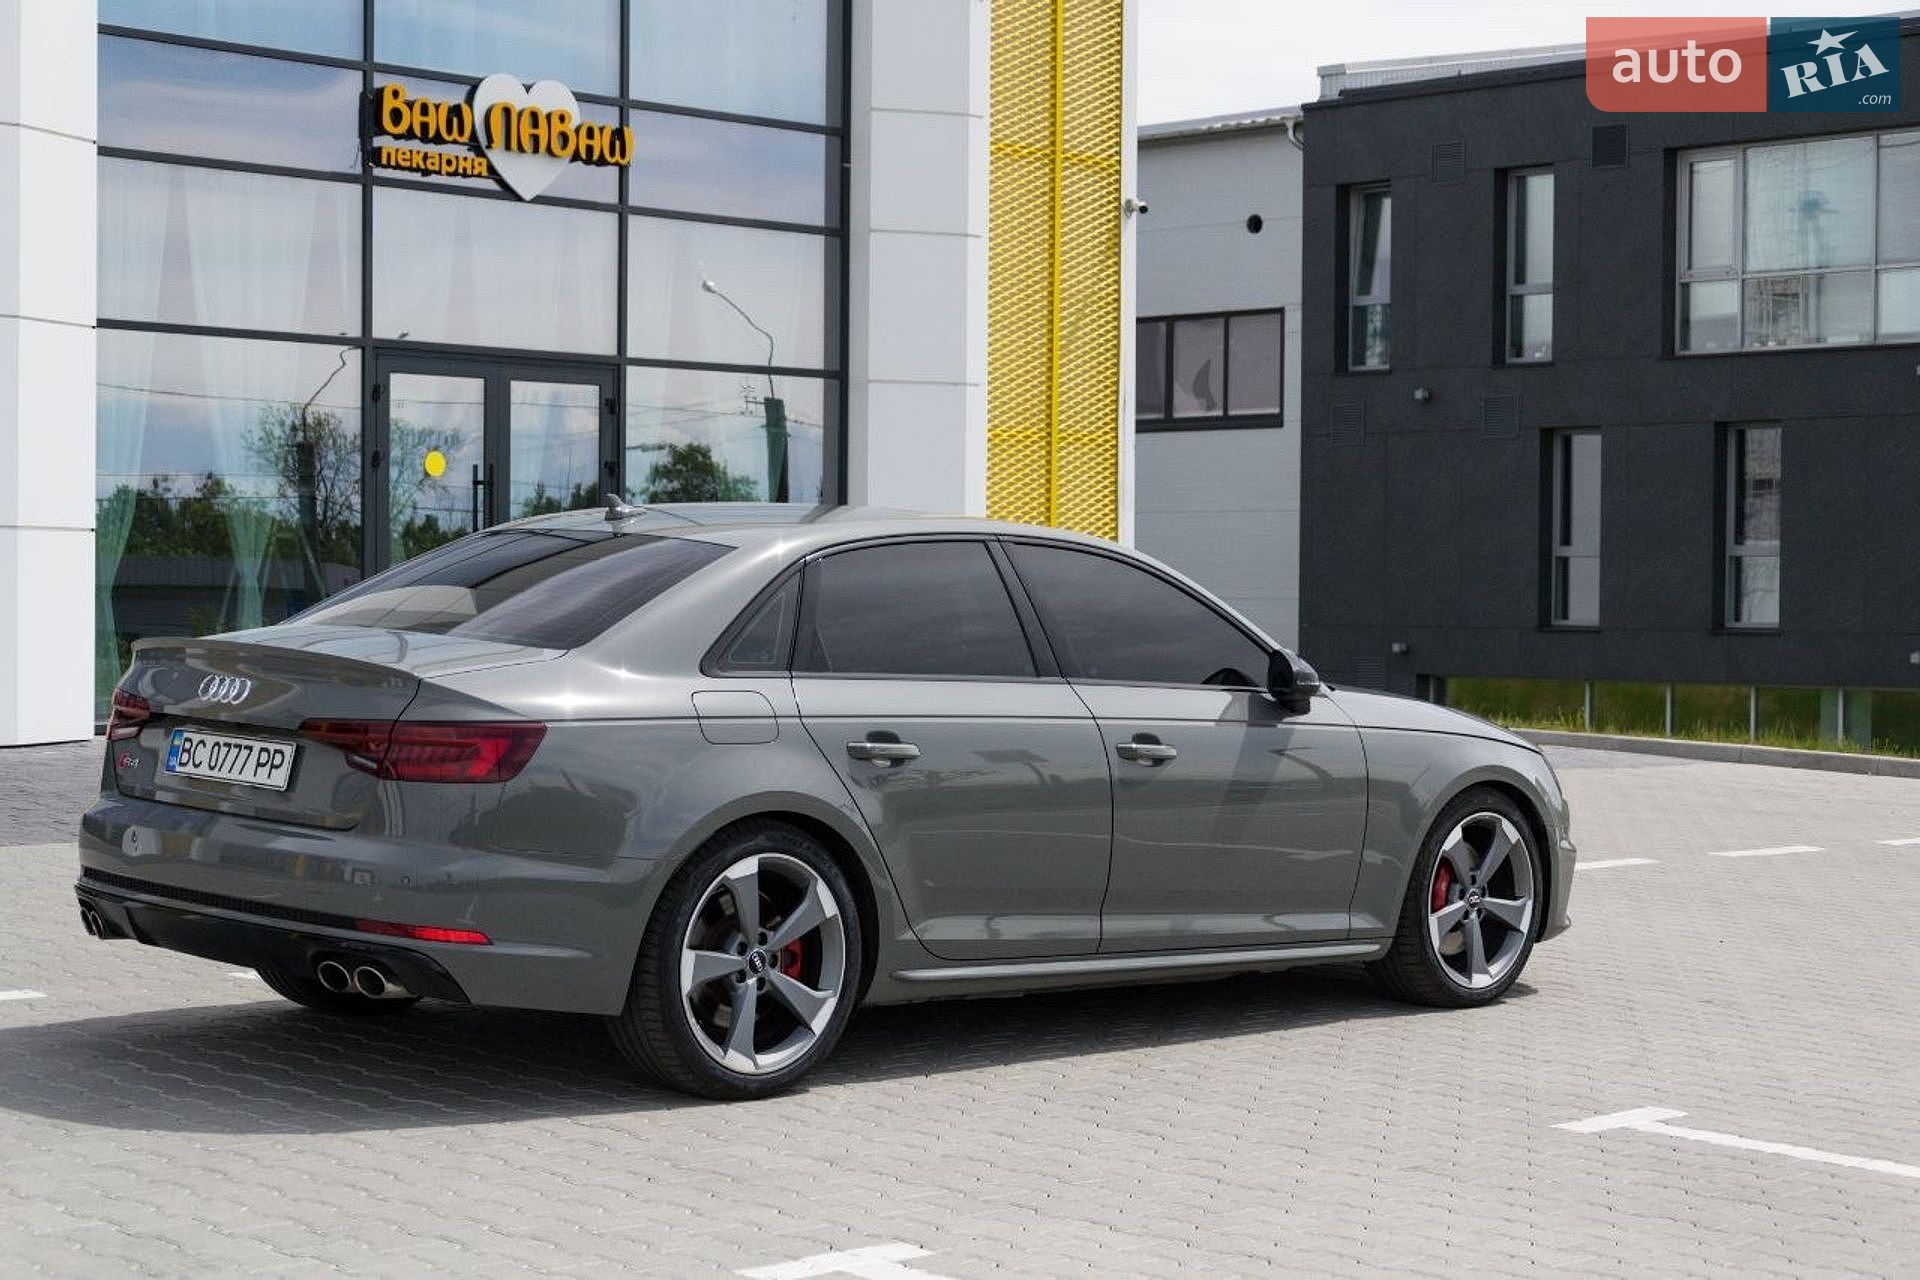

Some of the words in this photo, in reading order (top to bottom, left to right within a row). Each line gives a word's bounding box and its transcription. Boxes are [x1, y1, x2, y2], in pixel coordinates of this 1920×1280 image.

[380, 145, 488, 177] пекарня
[178, 736, 206, 769] BC
[208, 741, 253, 776] 0777
[253, 747, 285, 779] PP
